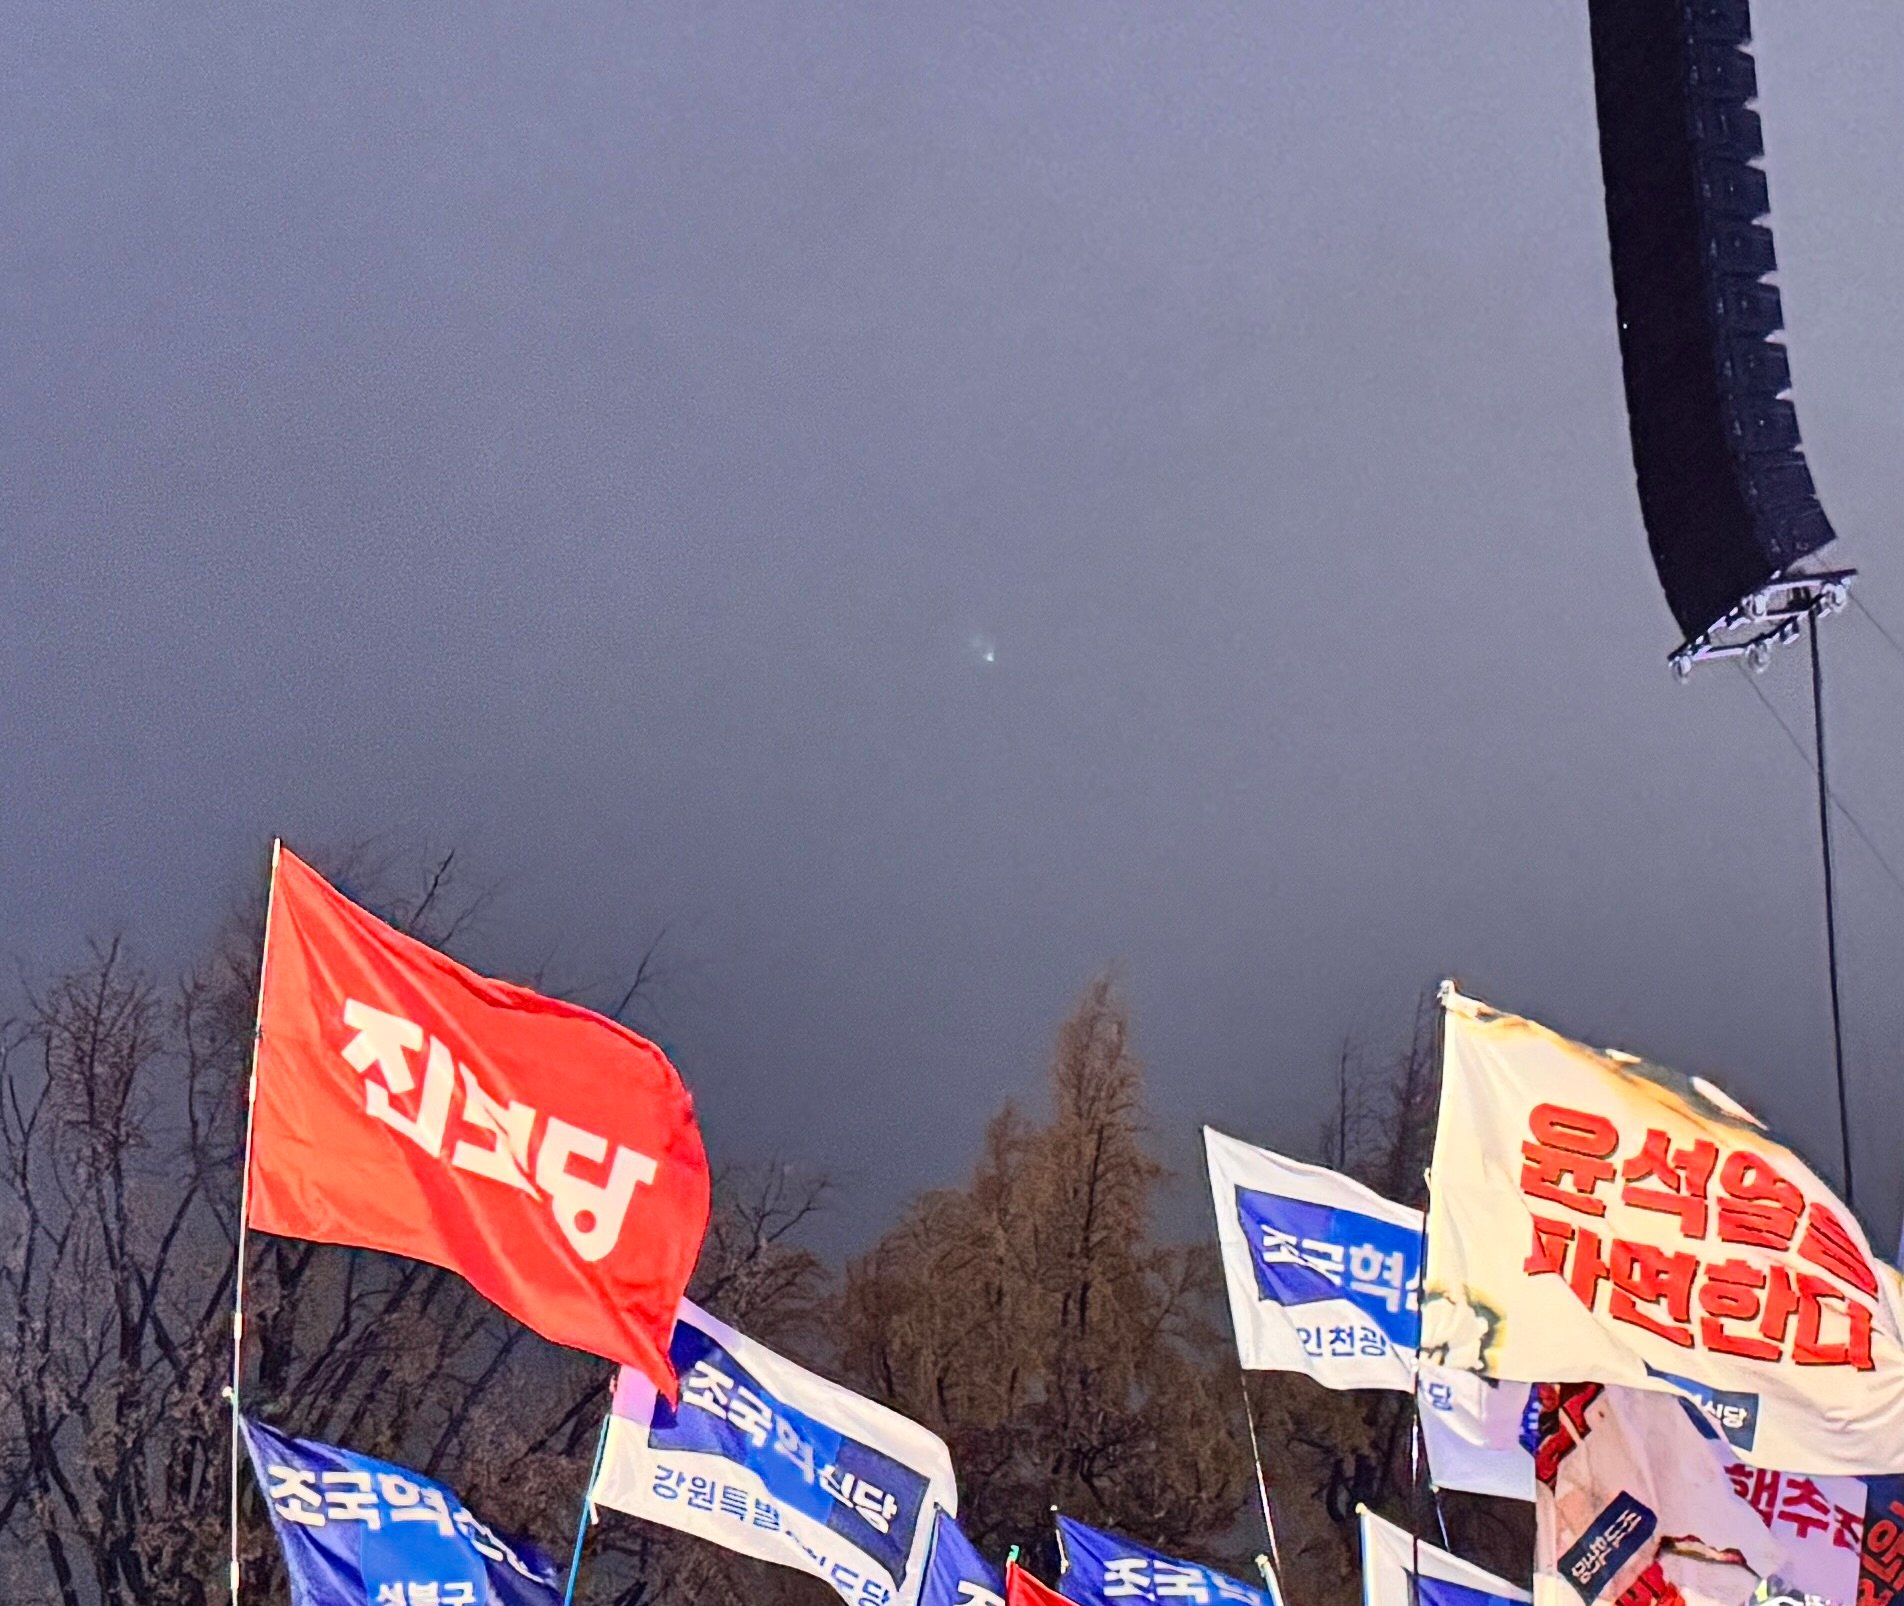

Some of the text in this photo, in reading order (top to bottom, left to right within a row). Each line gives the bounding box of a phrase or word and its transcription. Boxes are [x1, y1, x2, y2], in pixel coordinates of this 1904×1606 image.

[341, 998, 658, 1262] 진보당
[1520, 1102, 1880, 1299] 윤석열을
[1523, 1212, 1877, 1372] 파면한다
